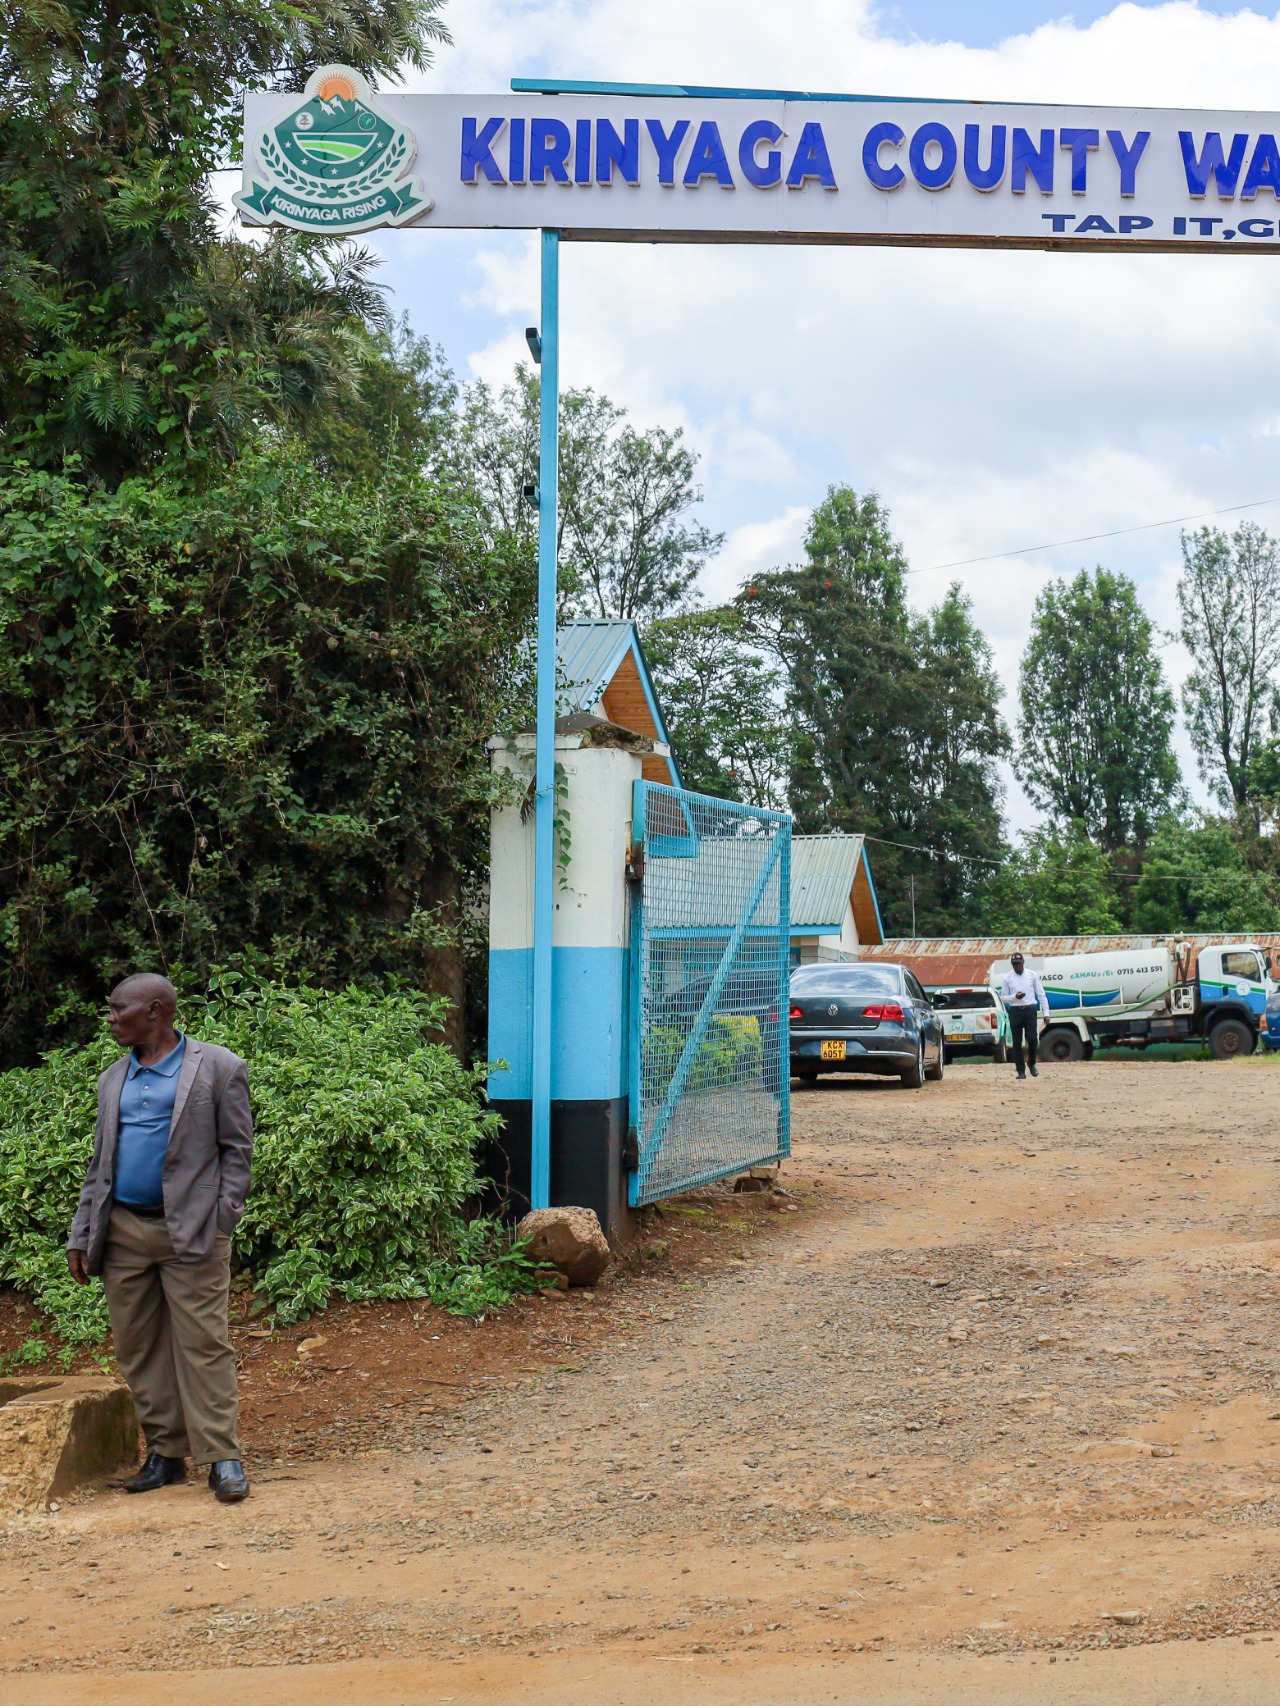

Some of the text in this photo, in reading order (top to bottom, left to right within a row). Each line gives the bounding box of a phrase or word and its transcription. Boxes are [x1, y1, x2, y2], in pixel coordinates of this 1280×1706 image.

[461, 117, 838, 190] KIRINYAGA
[862, 122, 1151, 198] COUNTY
[270, 194, 387, 221] KIRINYAGA RISING
[1042, 213, 1154, 233] TAP
[1039, 973, 1064, 982] ASCO
[1117, 968, 1134, 976] 0715
[1150, 965, 1163, 973] 591
[823, 1050, 843, 1058] 605T
[827, 1041, 844, 1049] KCX
